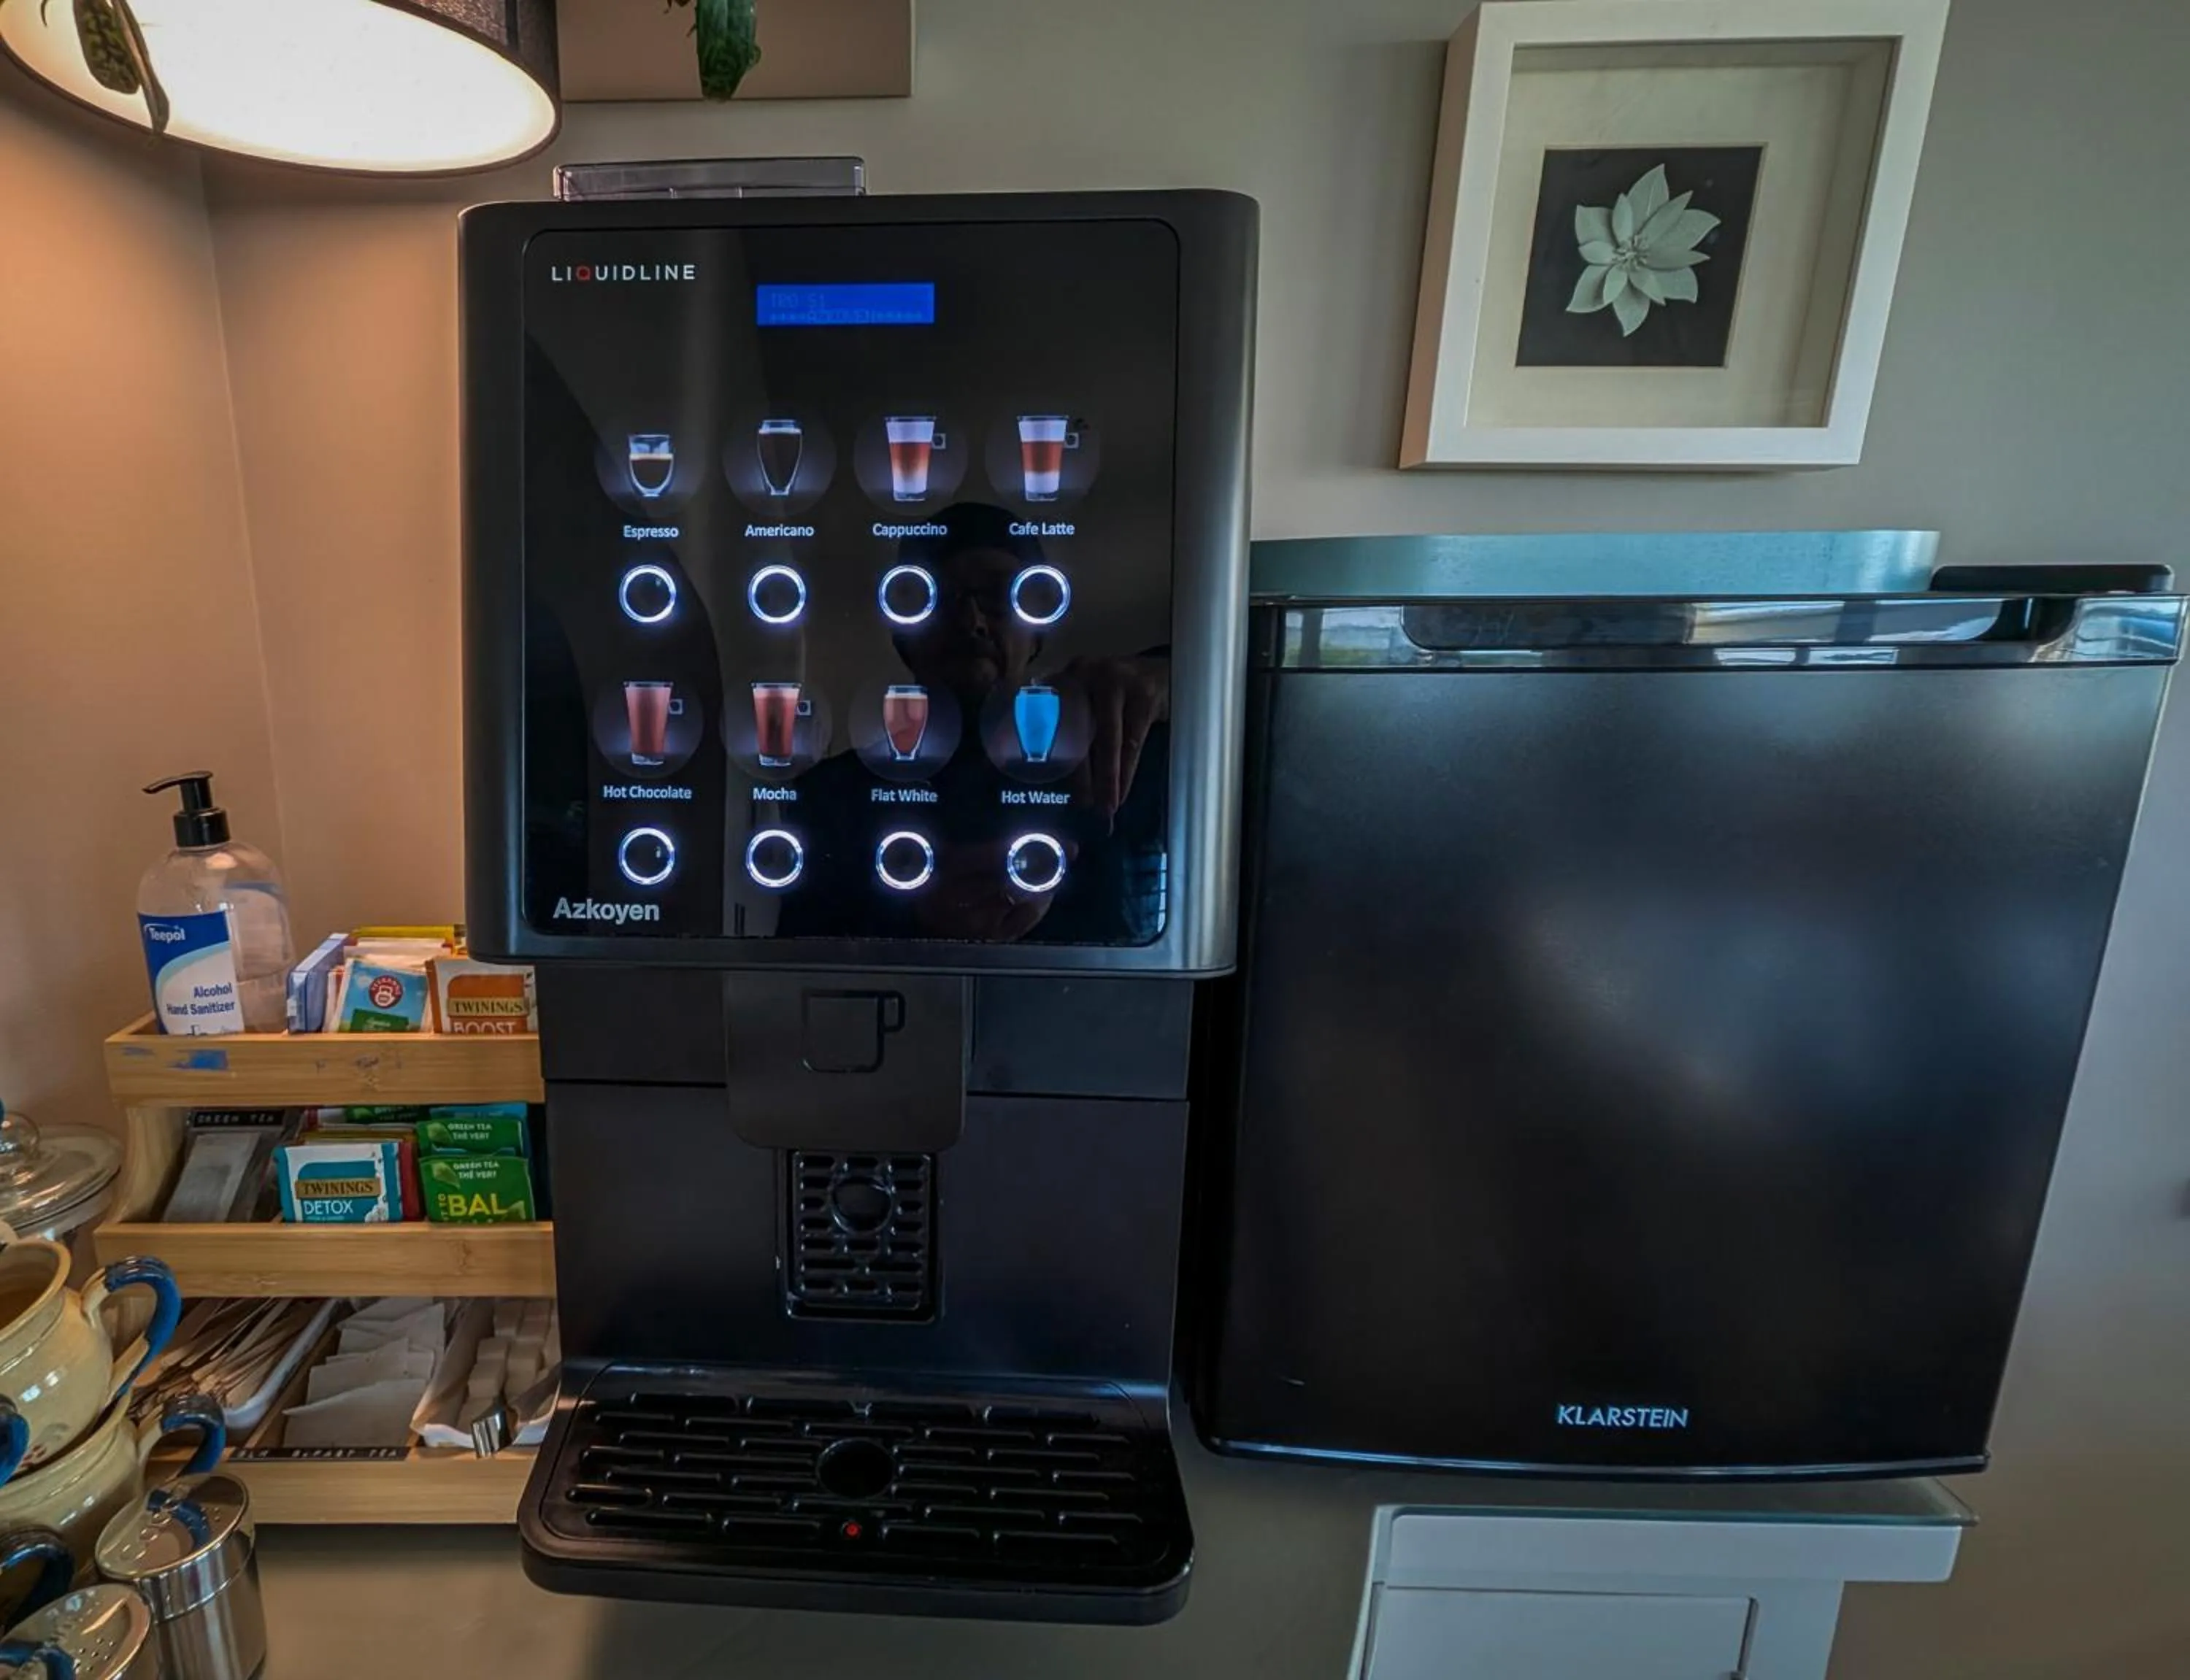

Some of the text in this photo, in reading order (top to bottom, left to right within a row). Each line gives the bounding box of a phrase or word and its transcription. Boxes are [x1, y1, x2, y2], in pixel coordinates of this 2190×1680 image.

[623, 525, 679, 539] Espresso
[745, 524, 814, 538] Americano
[872, 523, 948, 538] Cappuccino
[1009, 523, 1075, 536] Cafe Latte
[603, 785, 692, 800] Hot Chocolate
[753, 787, 797, 801] Mocha
[871, 788, 938, 803] Flat White
[1001, 790, 1070, 805] Hot Water
[553, 897, 659, 925] Azkoyen
[149, 928, 185, 943] Teepol
[193, 983, 232, 998] Alcohol
[191, 1001, 234, 1014] Sanitizer
[454, 999, 523, 1013] TWININGS
[454, 1021, 517, 1033] BOOST
[447, 1122, 492, 1131] GREEN TEA
[469, 1132, 490, 1140] VERT
[303, 1181, 373, 1194] TWININGS
[303, 1200, 354, 1215] DETOX
[447, 1192, 508, 1217] BAL
[1557, 1405, 1688, 1428] KLARSTEIN
